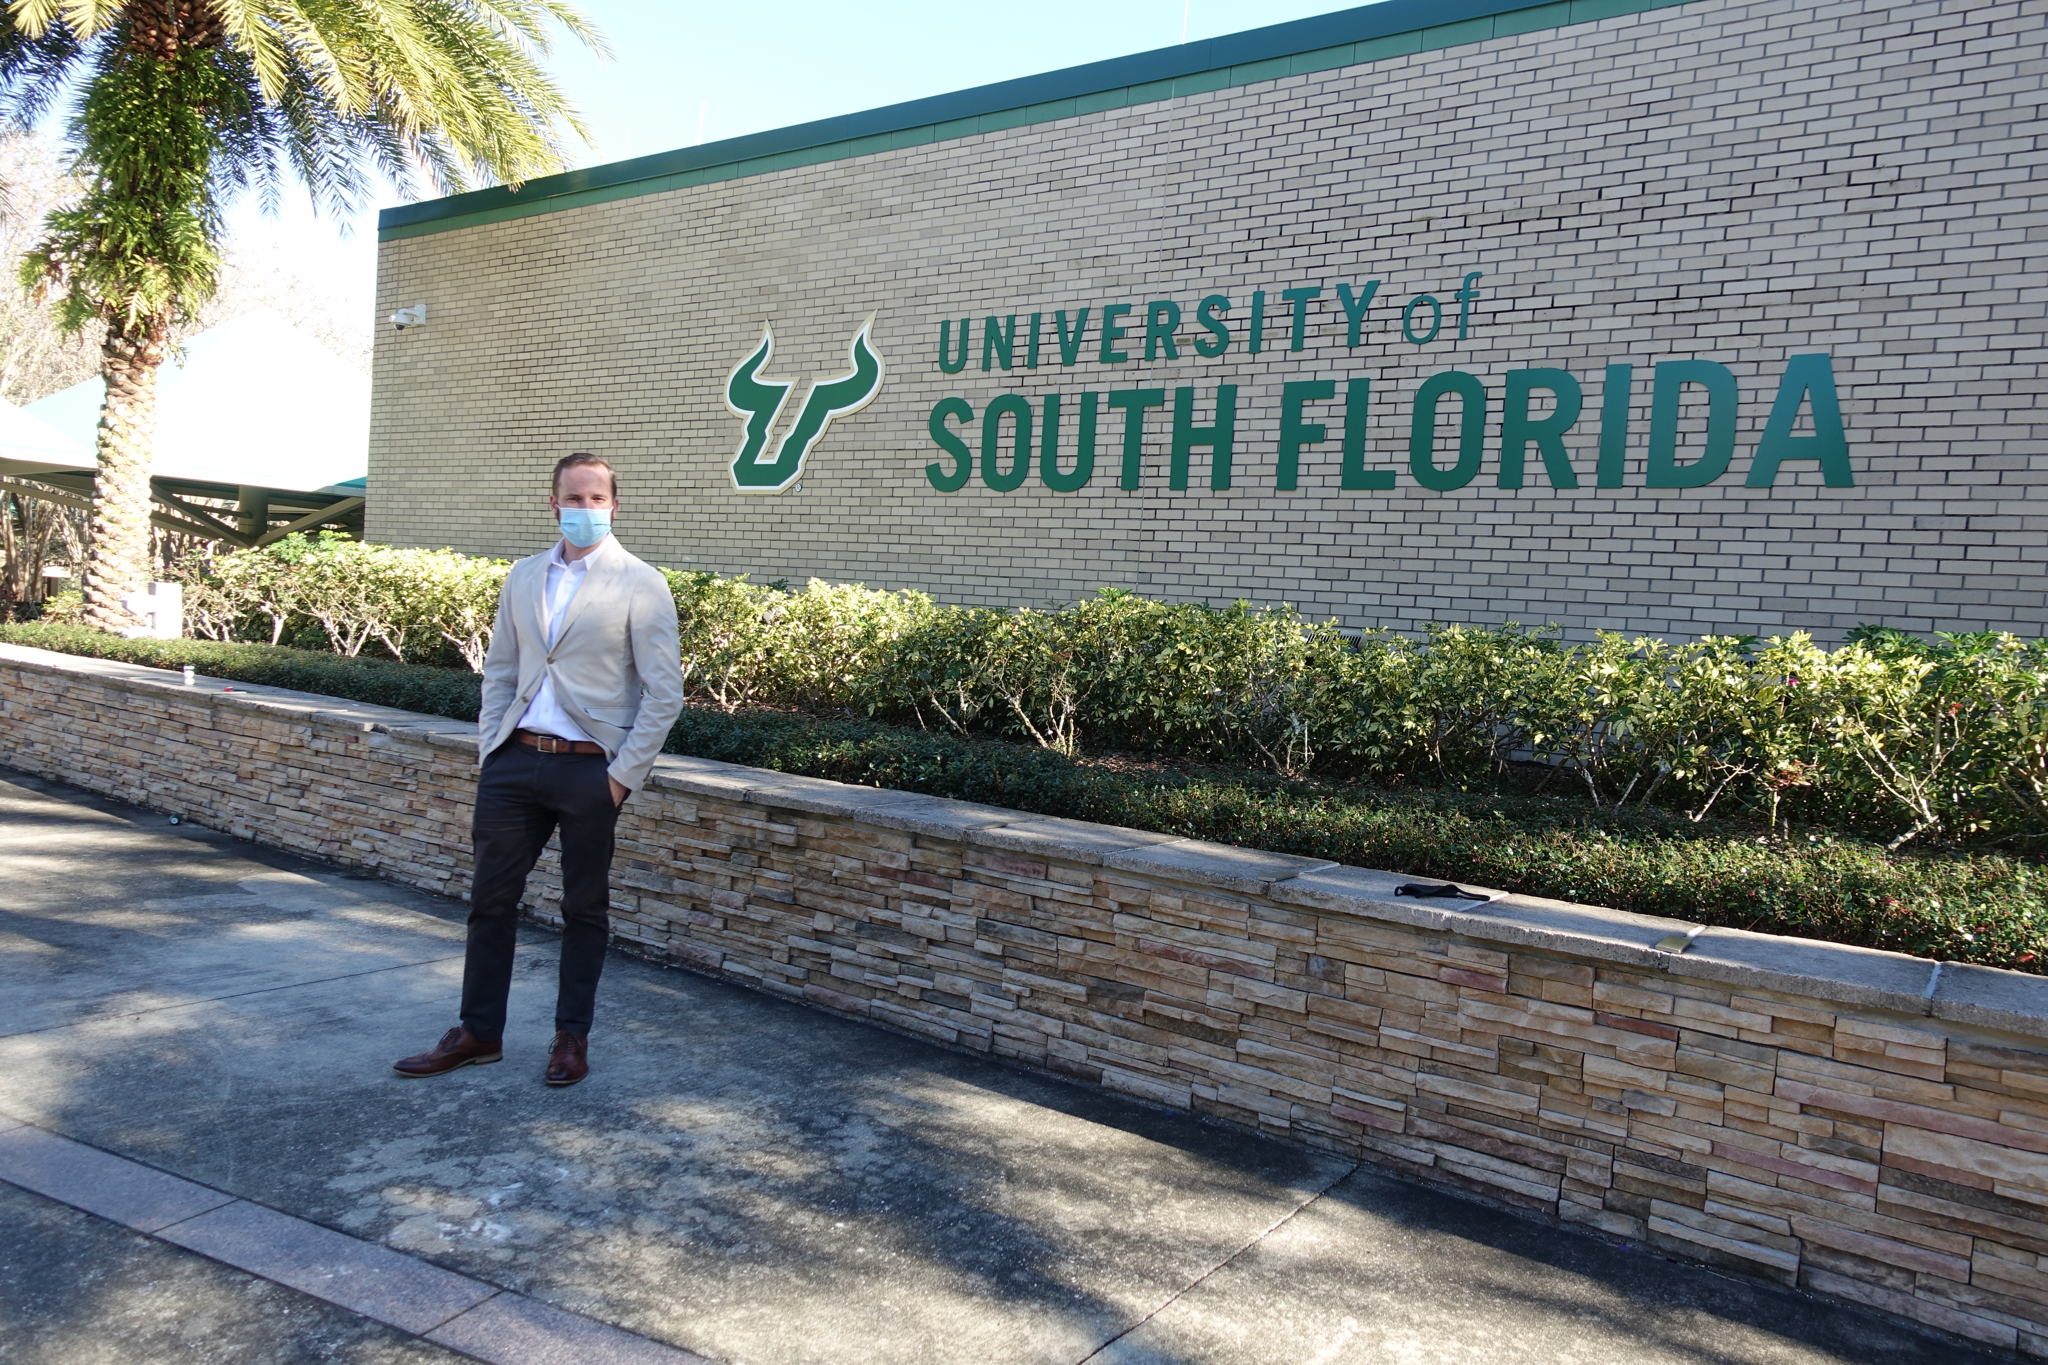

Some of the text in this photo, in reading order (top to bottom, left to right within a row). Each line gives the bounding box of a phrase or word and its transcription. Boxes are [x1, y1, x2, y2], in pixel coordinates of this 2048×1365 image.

[939, 271, 1483, 374] UNIVERSITY of
[925, 352, 1856, 493] SOUTH FLORIDA
